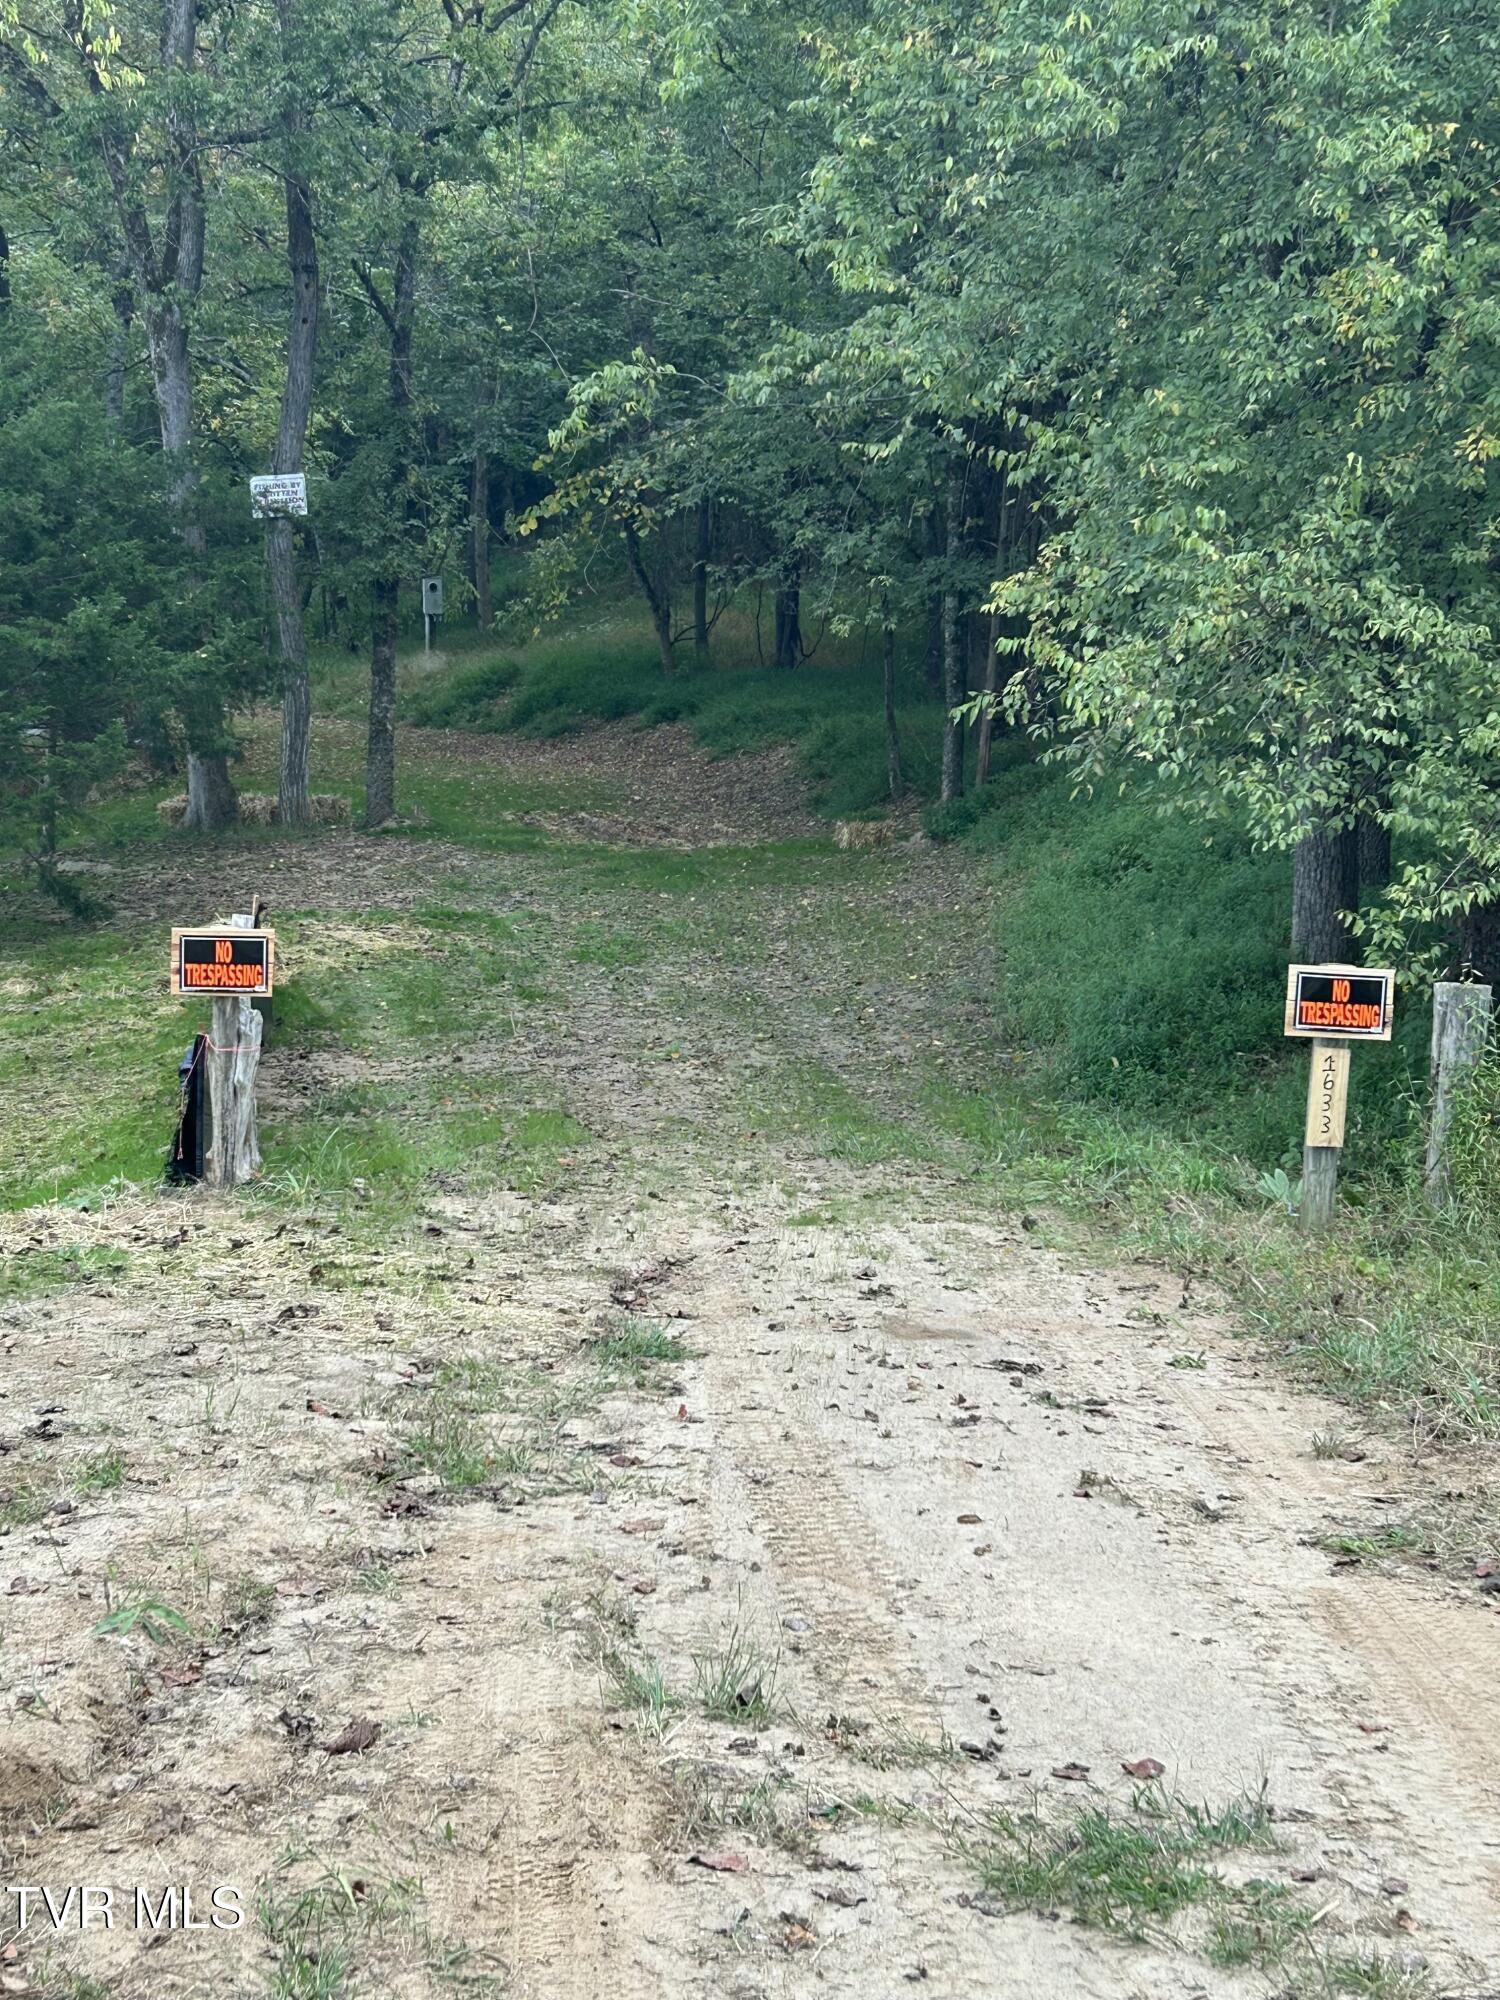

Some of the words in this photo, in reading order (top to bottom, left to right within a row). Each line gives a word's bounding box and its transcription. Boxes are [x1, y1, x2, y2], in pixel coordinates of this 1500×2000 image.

[290, 481, 301, 489] BY
[215, 941, 233, 963] NO
[185, 963, 262, 986] TRESPASSING
[1332, 980, 1351, 1002] NO
[1301, 1001, 1380, 1027] TRESPASSING
[1320, 1055, 1336, 1134] 1633
